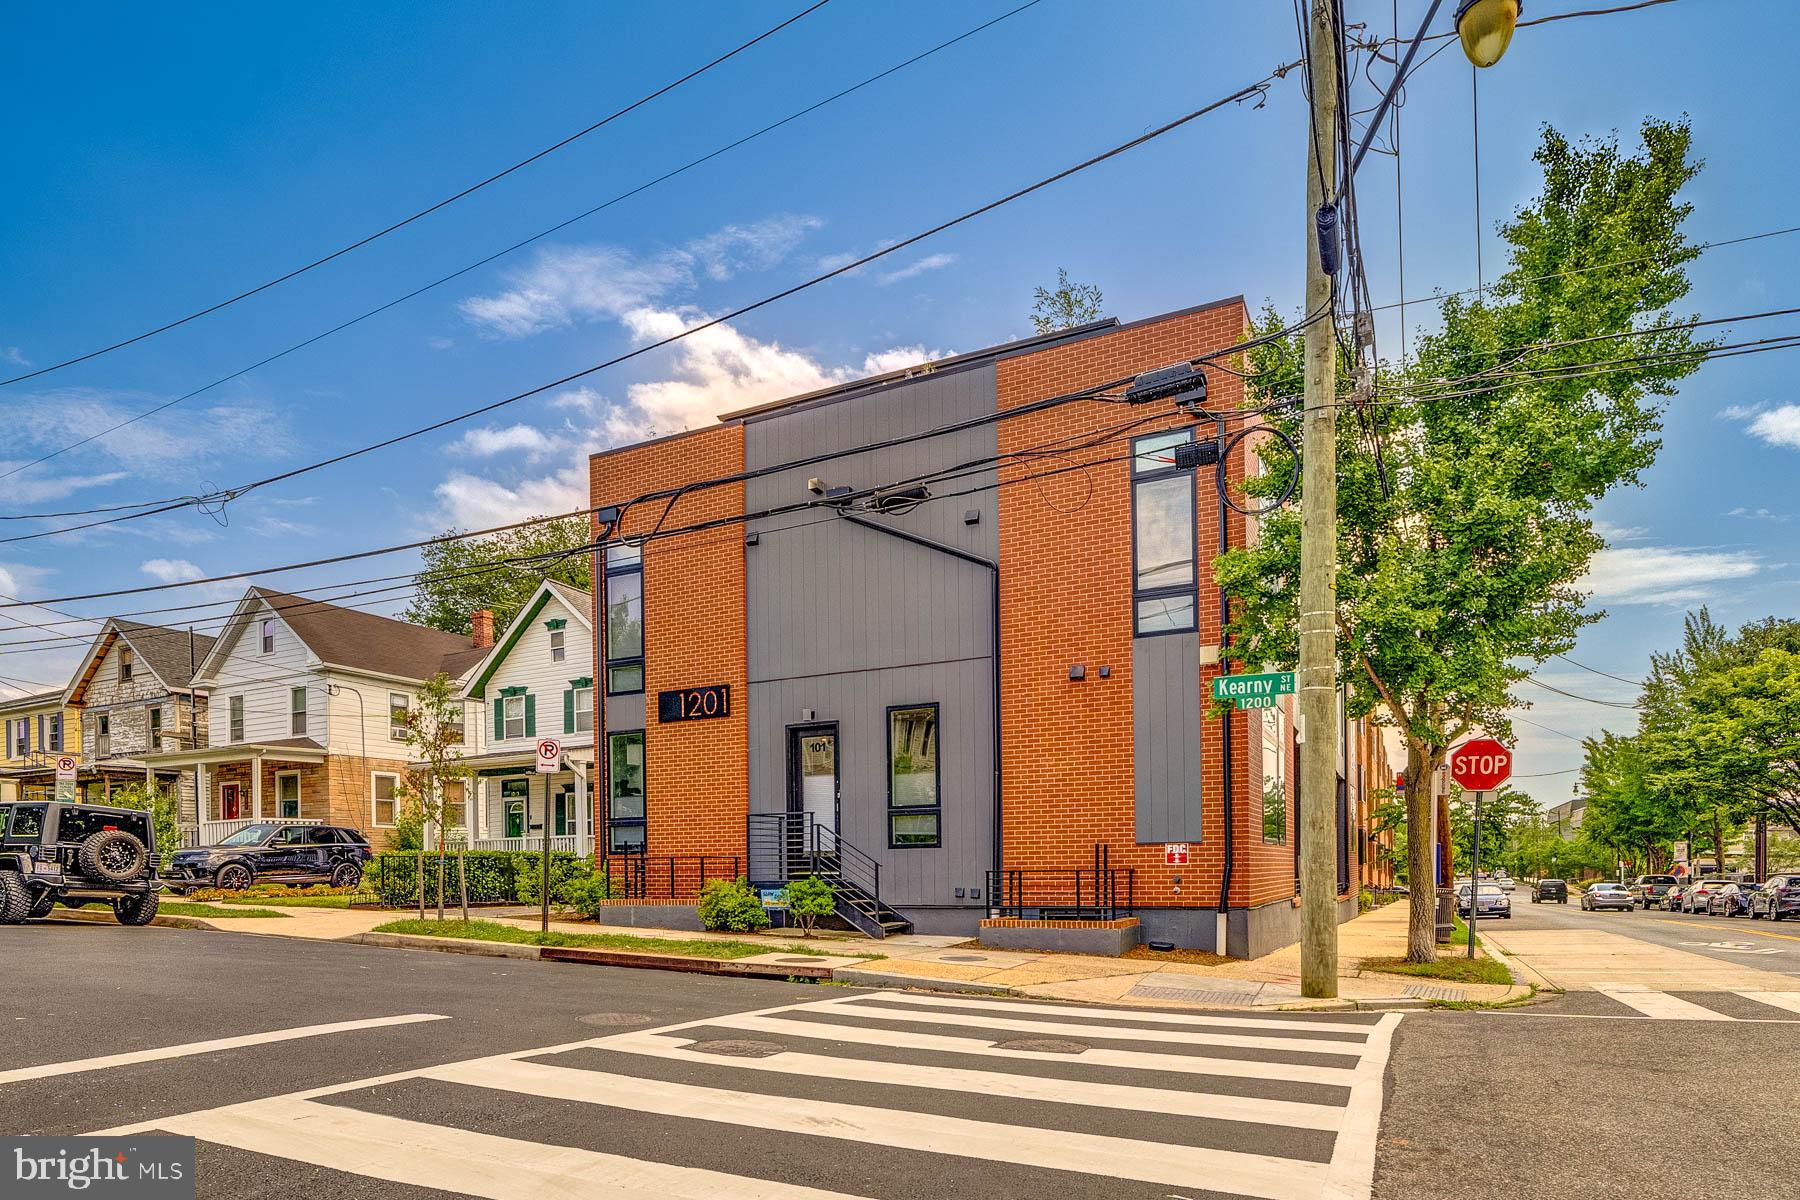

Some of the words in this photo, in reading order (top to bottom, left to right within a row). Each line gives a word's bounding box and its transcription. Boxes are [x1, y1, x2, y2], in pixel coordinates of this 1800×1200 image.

[1281, 675, 1291, 683] ST
[1219, 679, 1272, 696] Kearny
[1280, 684, 1291, 692] NE
[679, 688, 727, 718] 1201
[1241, 696, 1271, 710] 1200
[810, 742, 826, 752] 101
[1454, 755, 1508, 775] STOP
